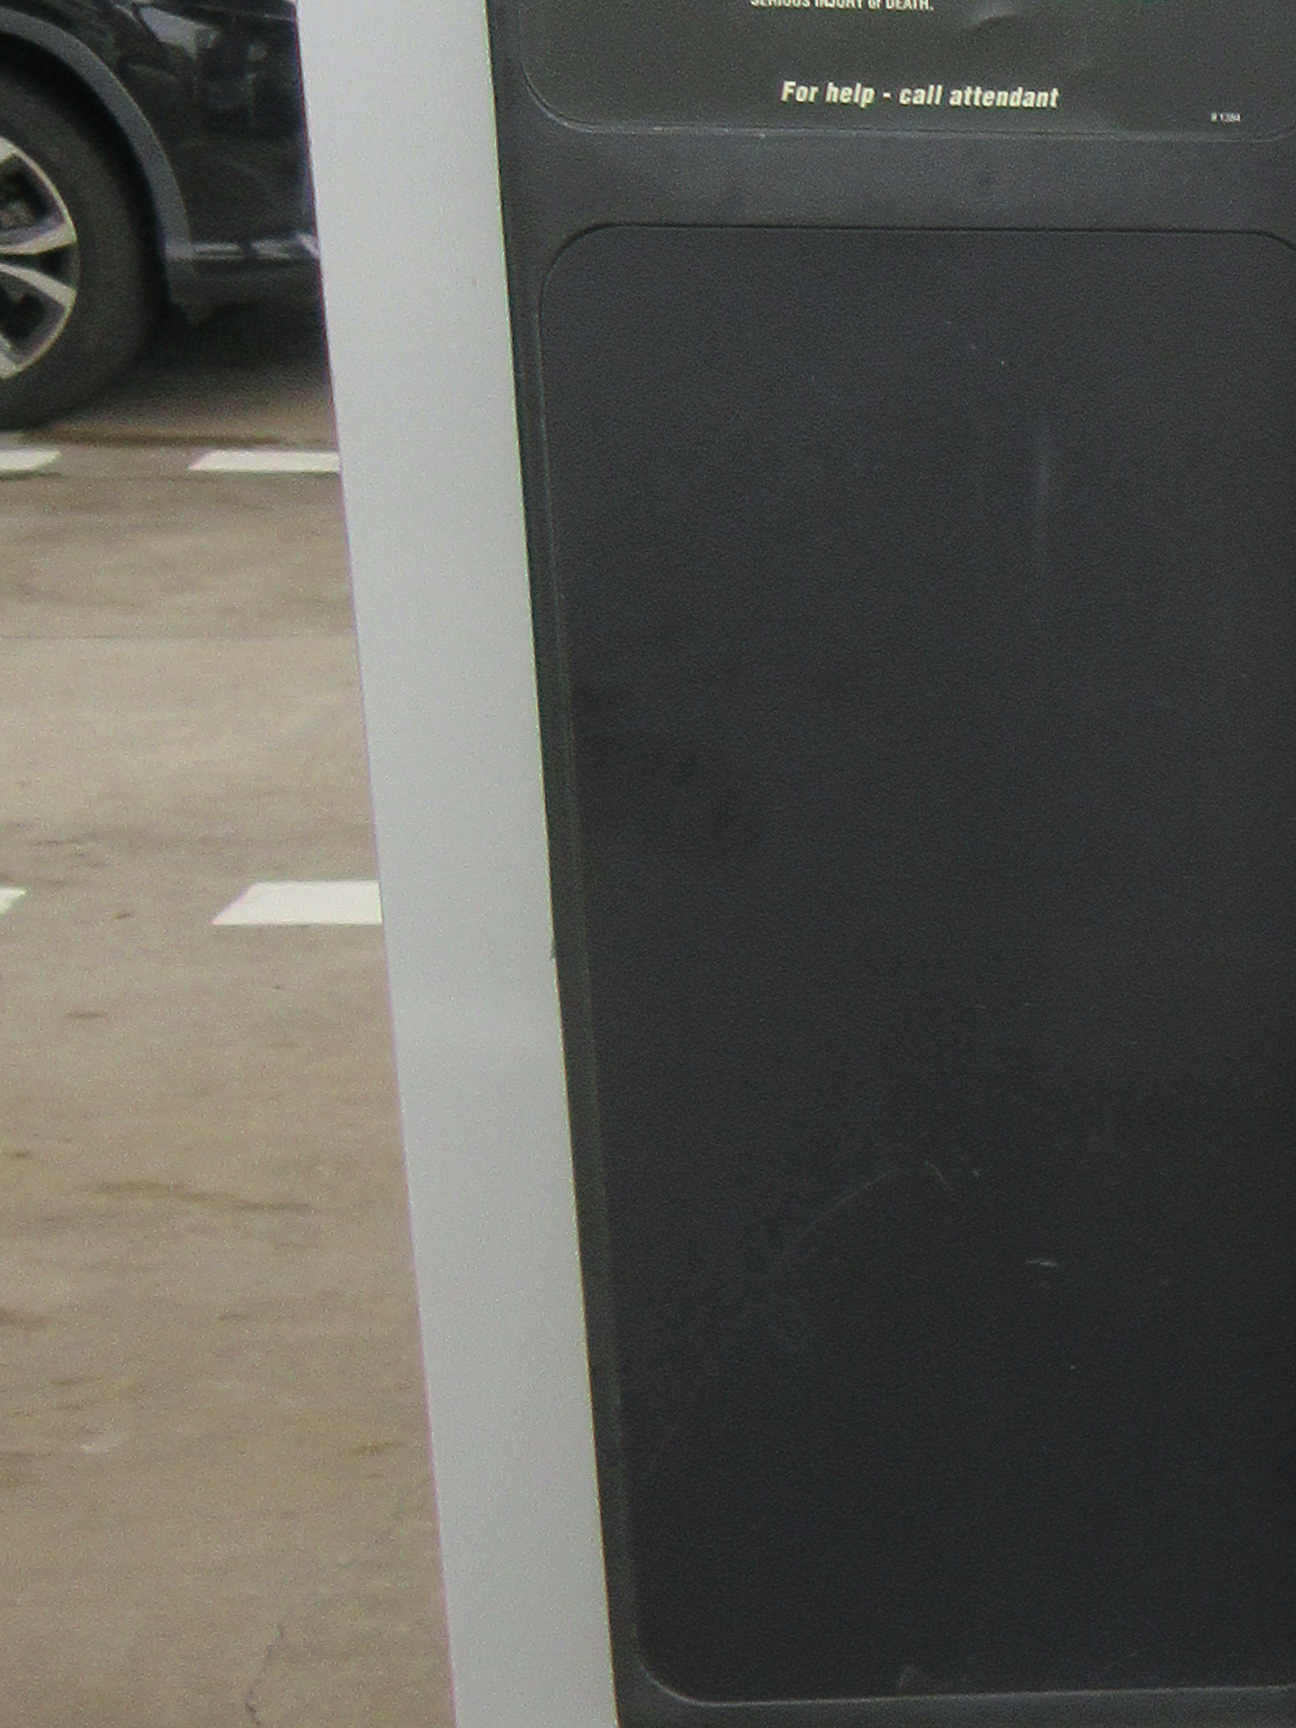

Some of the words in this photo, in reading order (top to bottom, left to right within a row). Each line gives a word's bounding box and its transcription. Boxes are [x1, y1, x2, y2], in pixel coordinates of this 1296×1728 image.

[781, 80, 819, 102] For
[825, 81, 875, 108] help
[898, 83, 943, 105] call
[948, 85, 1059, 108] attendant
